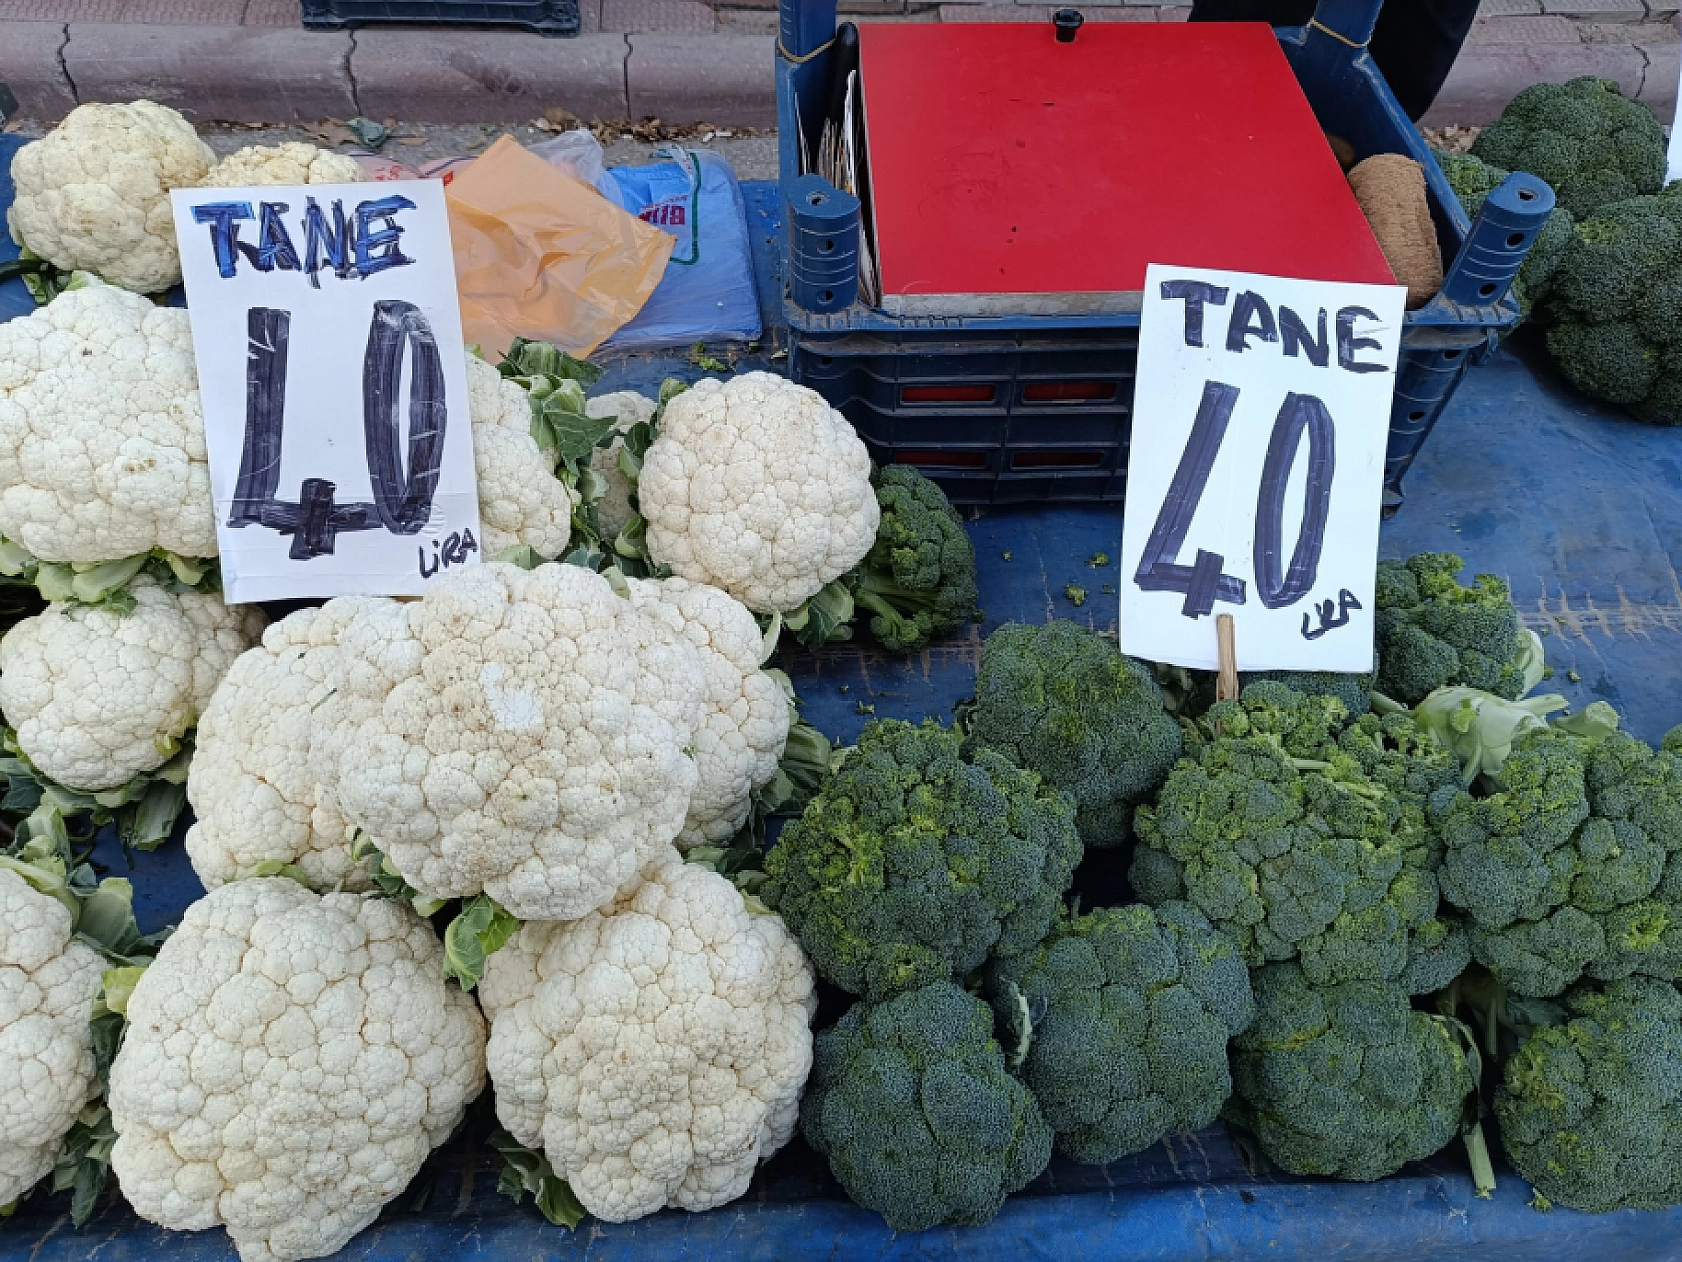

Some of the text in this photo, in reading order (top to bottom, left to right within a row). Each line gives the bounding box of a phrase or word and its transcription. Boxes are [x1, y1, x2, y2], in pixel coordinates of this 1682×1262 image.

[190, 195, 417, 289] TANE
[1160, 279, 1390, 374] TANE
[227, 300, 448, 560] 40
[1133, 379, 1336, 620] 40
